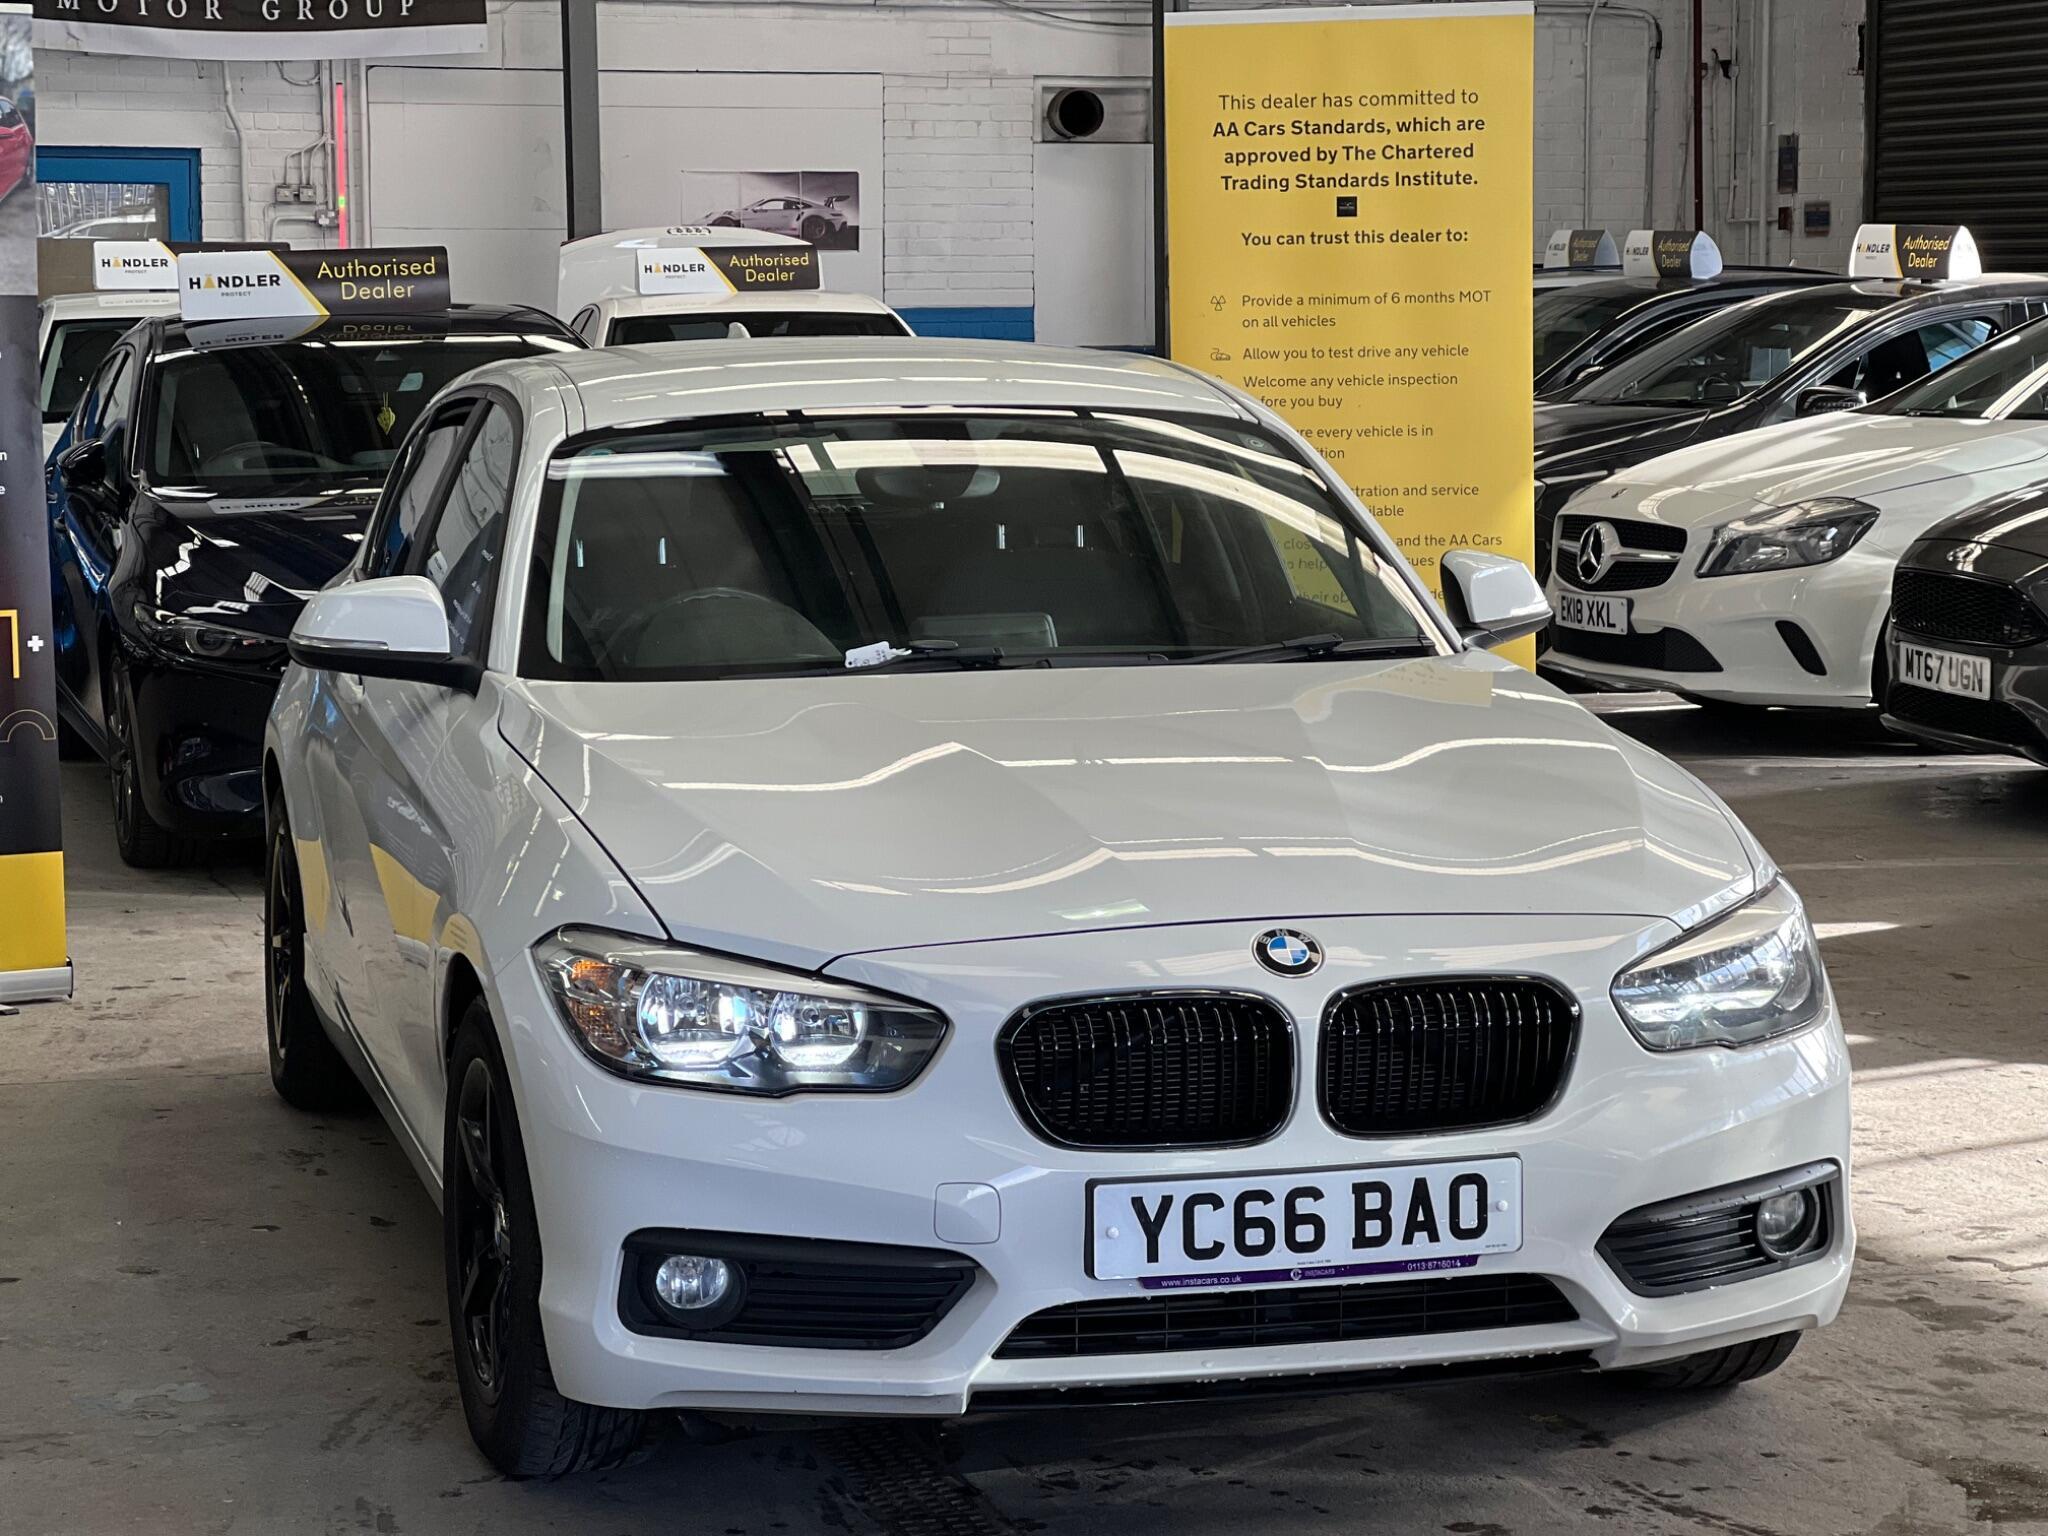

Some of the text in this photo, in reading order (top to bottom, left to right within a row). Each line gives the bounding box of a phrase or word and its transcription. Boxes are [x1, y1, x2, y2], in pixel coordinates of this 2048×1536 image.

[1219, 89, 1478, 110] This dealer has committed to
[1213, 117, 1485, 137] AA Cars Standards, which are
[1225, 143, 1473, 166] approved by The Chartered
[1221, 171, 1477, 192] Trading Standards Institute.
[1242, 229, 1467, 246] You can trust this dealer to:
[1659, 238, 1692, 252] Authorised
[1903, 235, 1952, 250] Authorised
[317, 257, 436, 279] Authorised
[729, 253, 809, 267] Authorised
[1662, 254, 1682, 268] Dealer
[1908, 252, 1937, 268] Dealer
[746, 268, 795, 282] Dealer
[341, 280, 415, 300] Dealer
[1243, 290, 1491, 306] Provide a minimum of 6 months MOT
[1243, 315, 1336, 328] on all vehicles
[1243, 345, 1469, 361] Allow you to test drive any vehicle
[1244, 373, 1457, 389] Welcome any vehicle inspection
[1290, 398, 1314, 409] you
[1319, 395, 1342, 408] buy
[1317, 429, 1352, 440] every
[1356, 425, 1403, 437] vehicle
[1408, 425, 1417, 436] is
[1422, 425, 1433, 436] in
[1403, 484, 1427, 496] and
[1432, 484, 1478, 495] service
[1396, 535, 1421, 546] and
[1425, 535, 1445, 546] the
[1449, 534, 1468, 546] AA
[1472, 534, 1502, 545] Cars
[1587, 600, 1616, 628] XKL
[1906, 648, 1982, 692] MT67 UGN
[1131, 1173, 1488, 1264] YC66 BAO
[1161, 1275, 1242, 1287] www.instacars.co.uk
